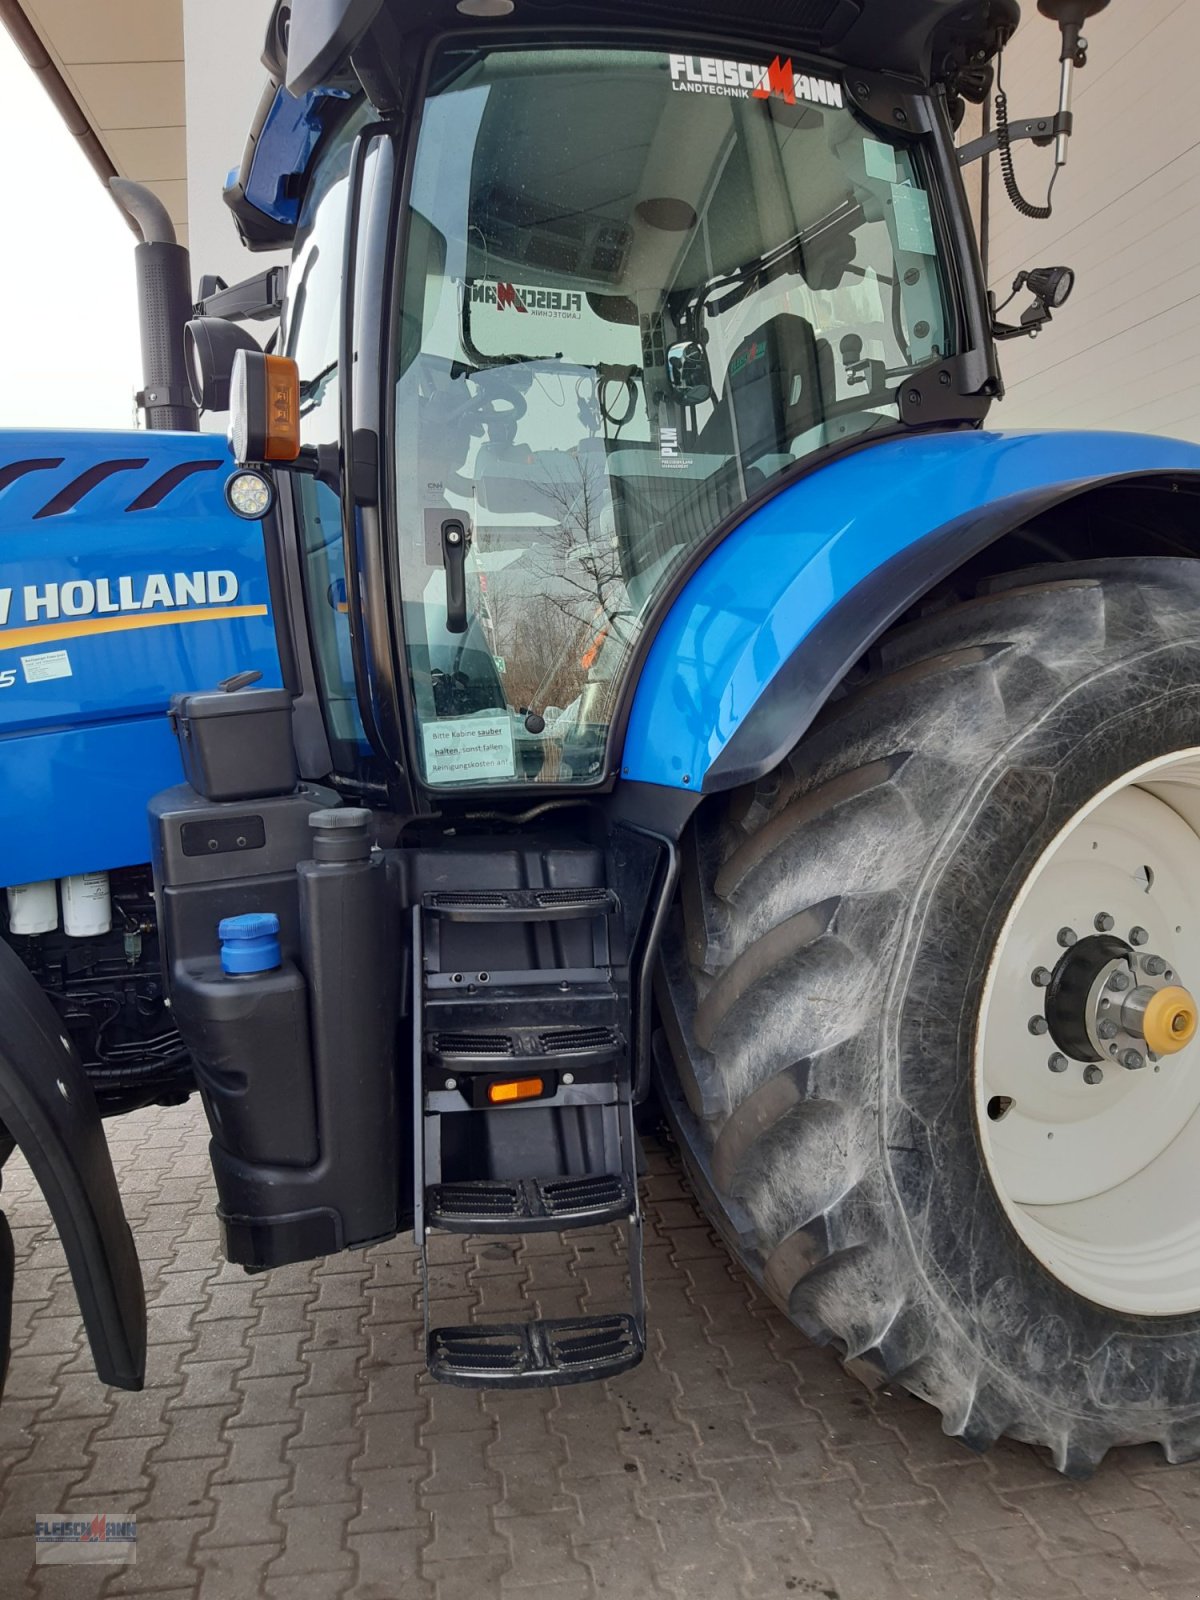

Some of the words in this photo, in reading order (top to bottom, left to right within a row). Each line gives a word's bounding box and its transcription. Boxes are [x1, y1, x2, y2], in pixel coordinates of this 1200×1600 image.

[669, 54, 843, 108] FLEISCHMANN
[672, 82, 749, 99] LANDTECHNIK
[660, 427, 678, 457] PLM
[24, 570, 239, 622] HOLLAND
[432, 732, 450, 740] Bitte
[452, 730, 476, 738] Kabine
[478, 728, 502, 737] sauber
[434, 747, 461, 756] halten,
[462, 746, 481, 754] sonst
[482, 743, 504, 752] fallen
[432, 760, 495, 772] Reinigungskosten
